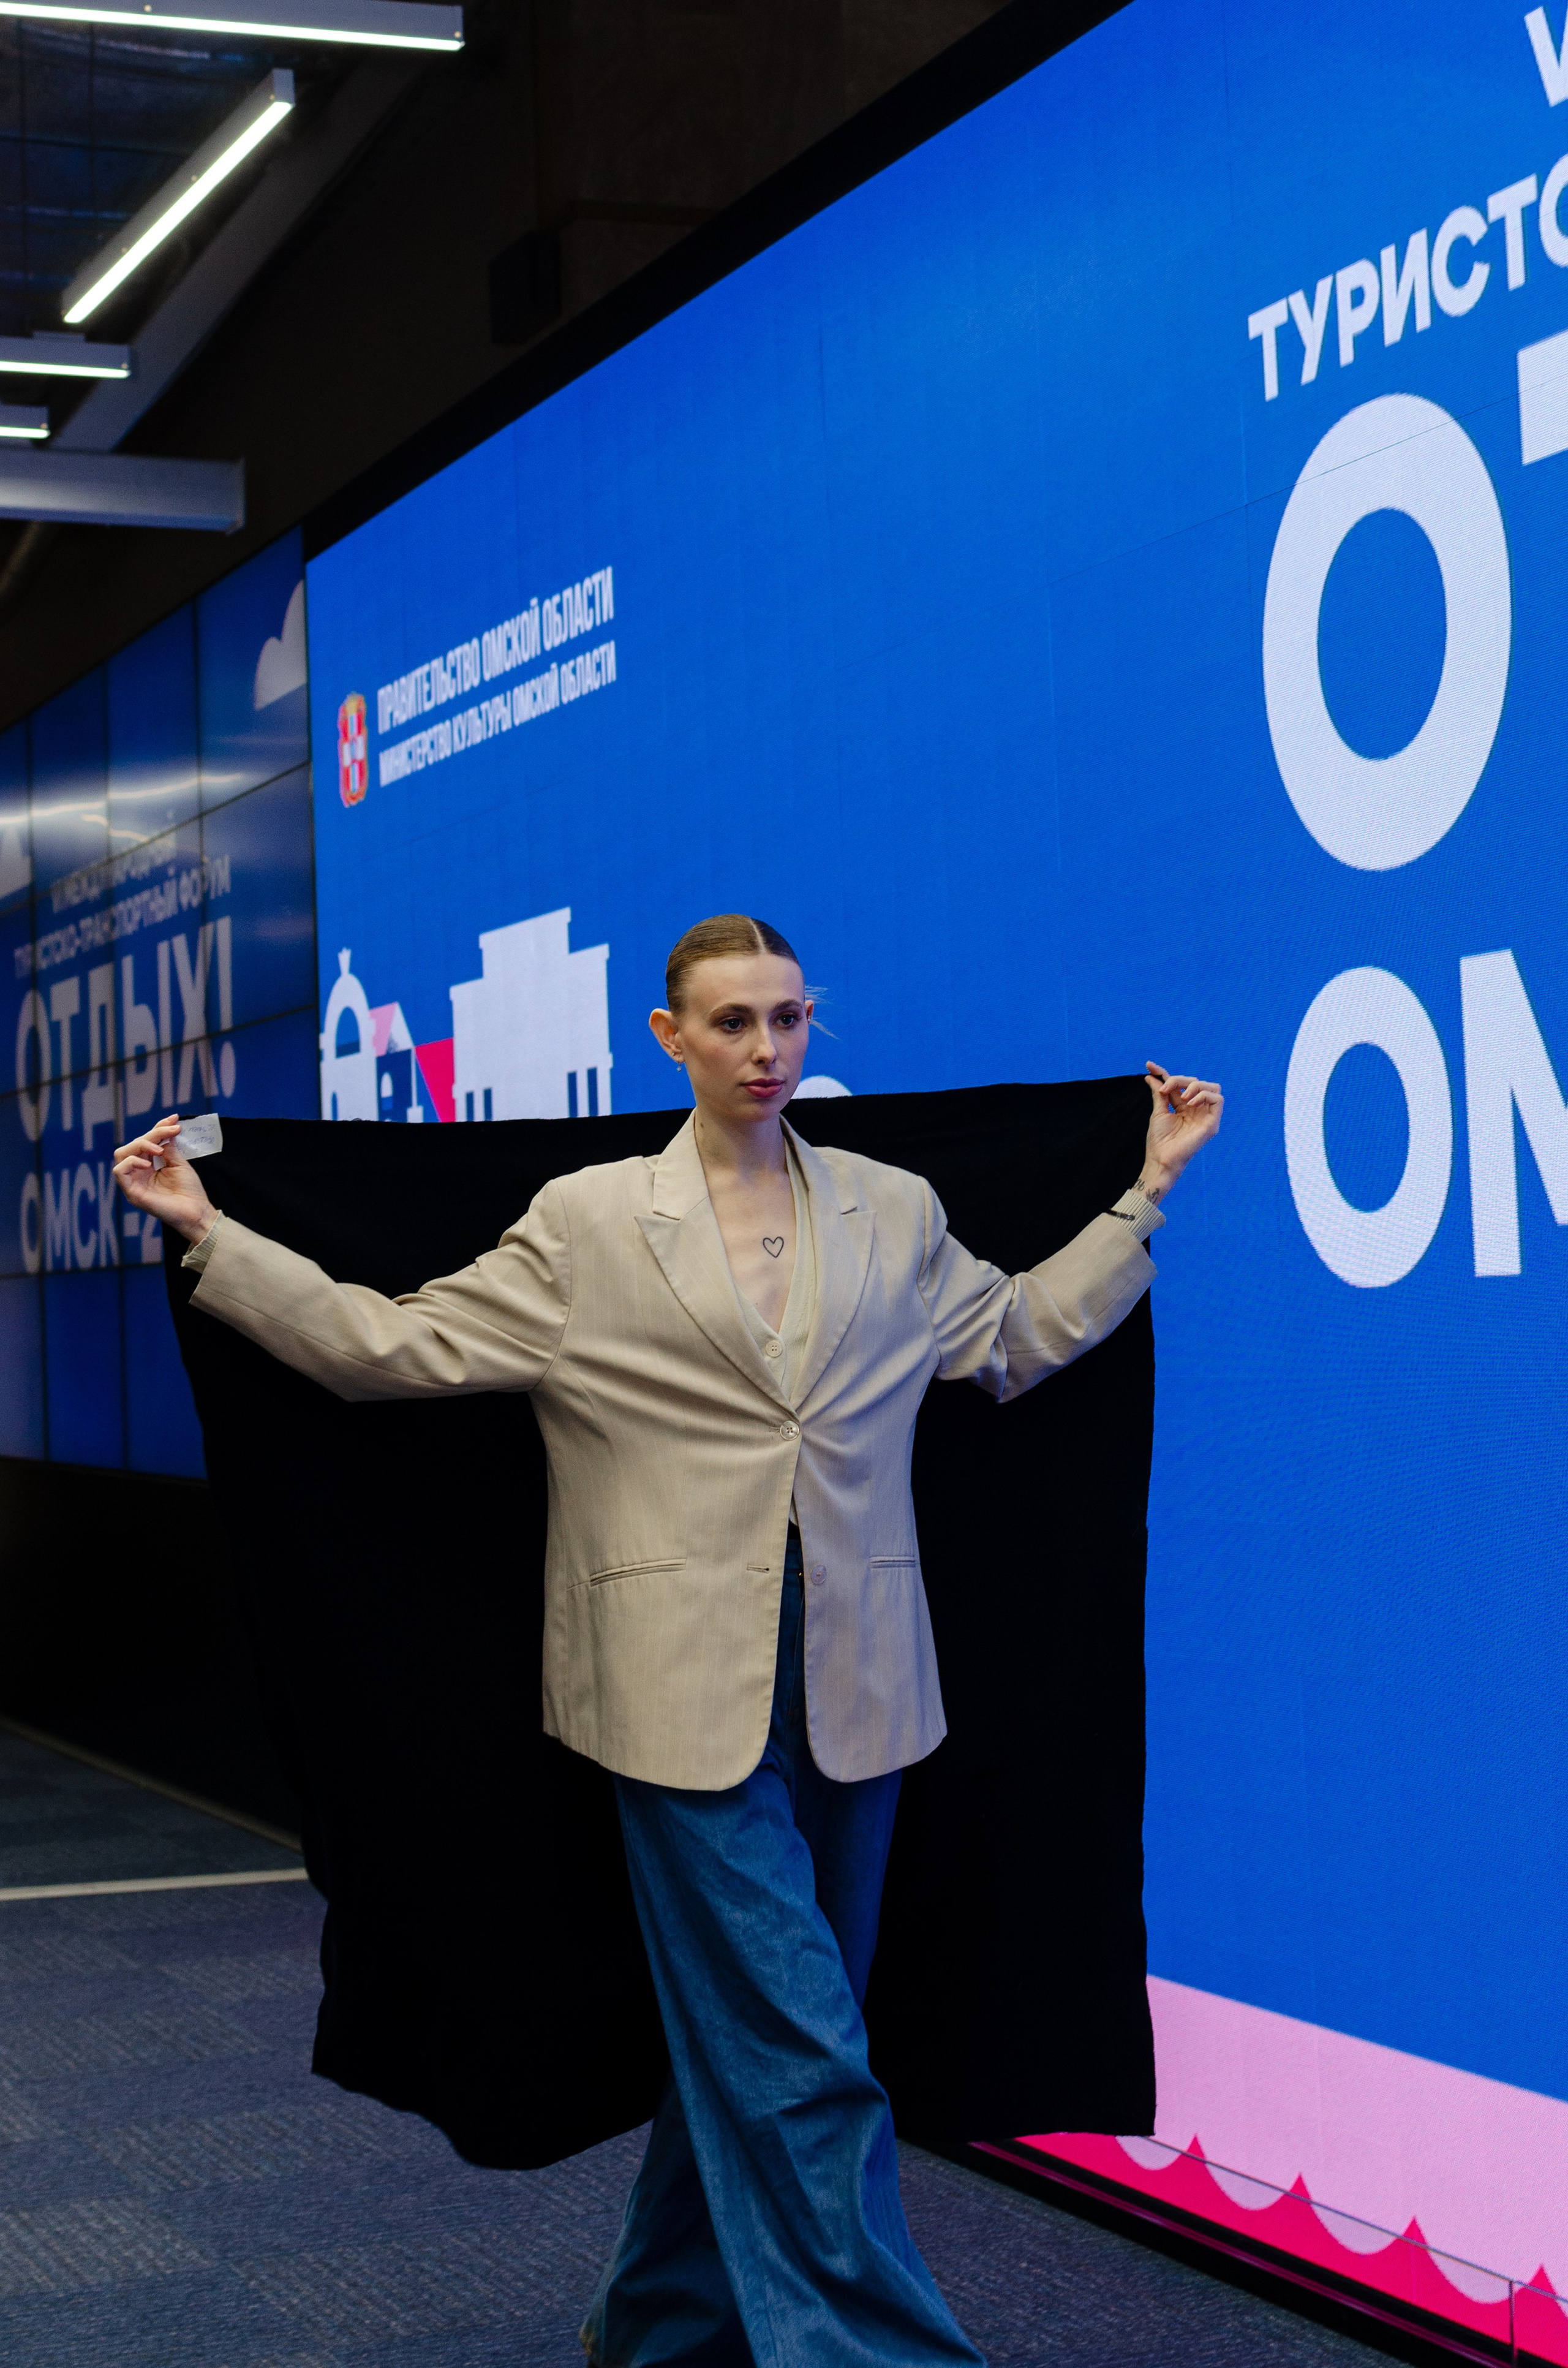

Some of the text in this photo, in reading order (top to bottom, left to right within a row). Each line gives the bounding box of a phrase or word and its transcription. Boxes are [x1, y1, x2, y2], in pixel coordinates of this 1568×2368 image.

[377, 566, 614, 735] ПРАВИТЕЛЬСТВО ОМСКОЙ ОБЛАСТИ
[379, 640, 616, 787] МИНИСТЕРСТВО КУЛЬТУРЫ ОМСКОЙ ОБЛАСТИ
[16, 917, 236, 1151] ОТДЫХ!
